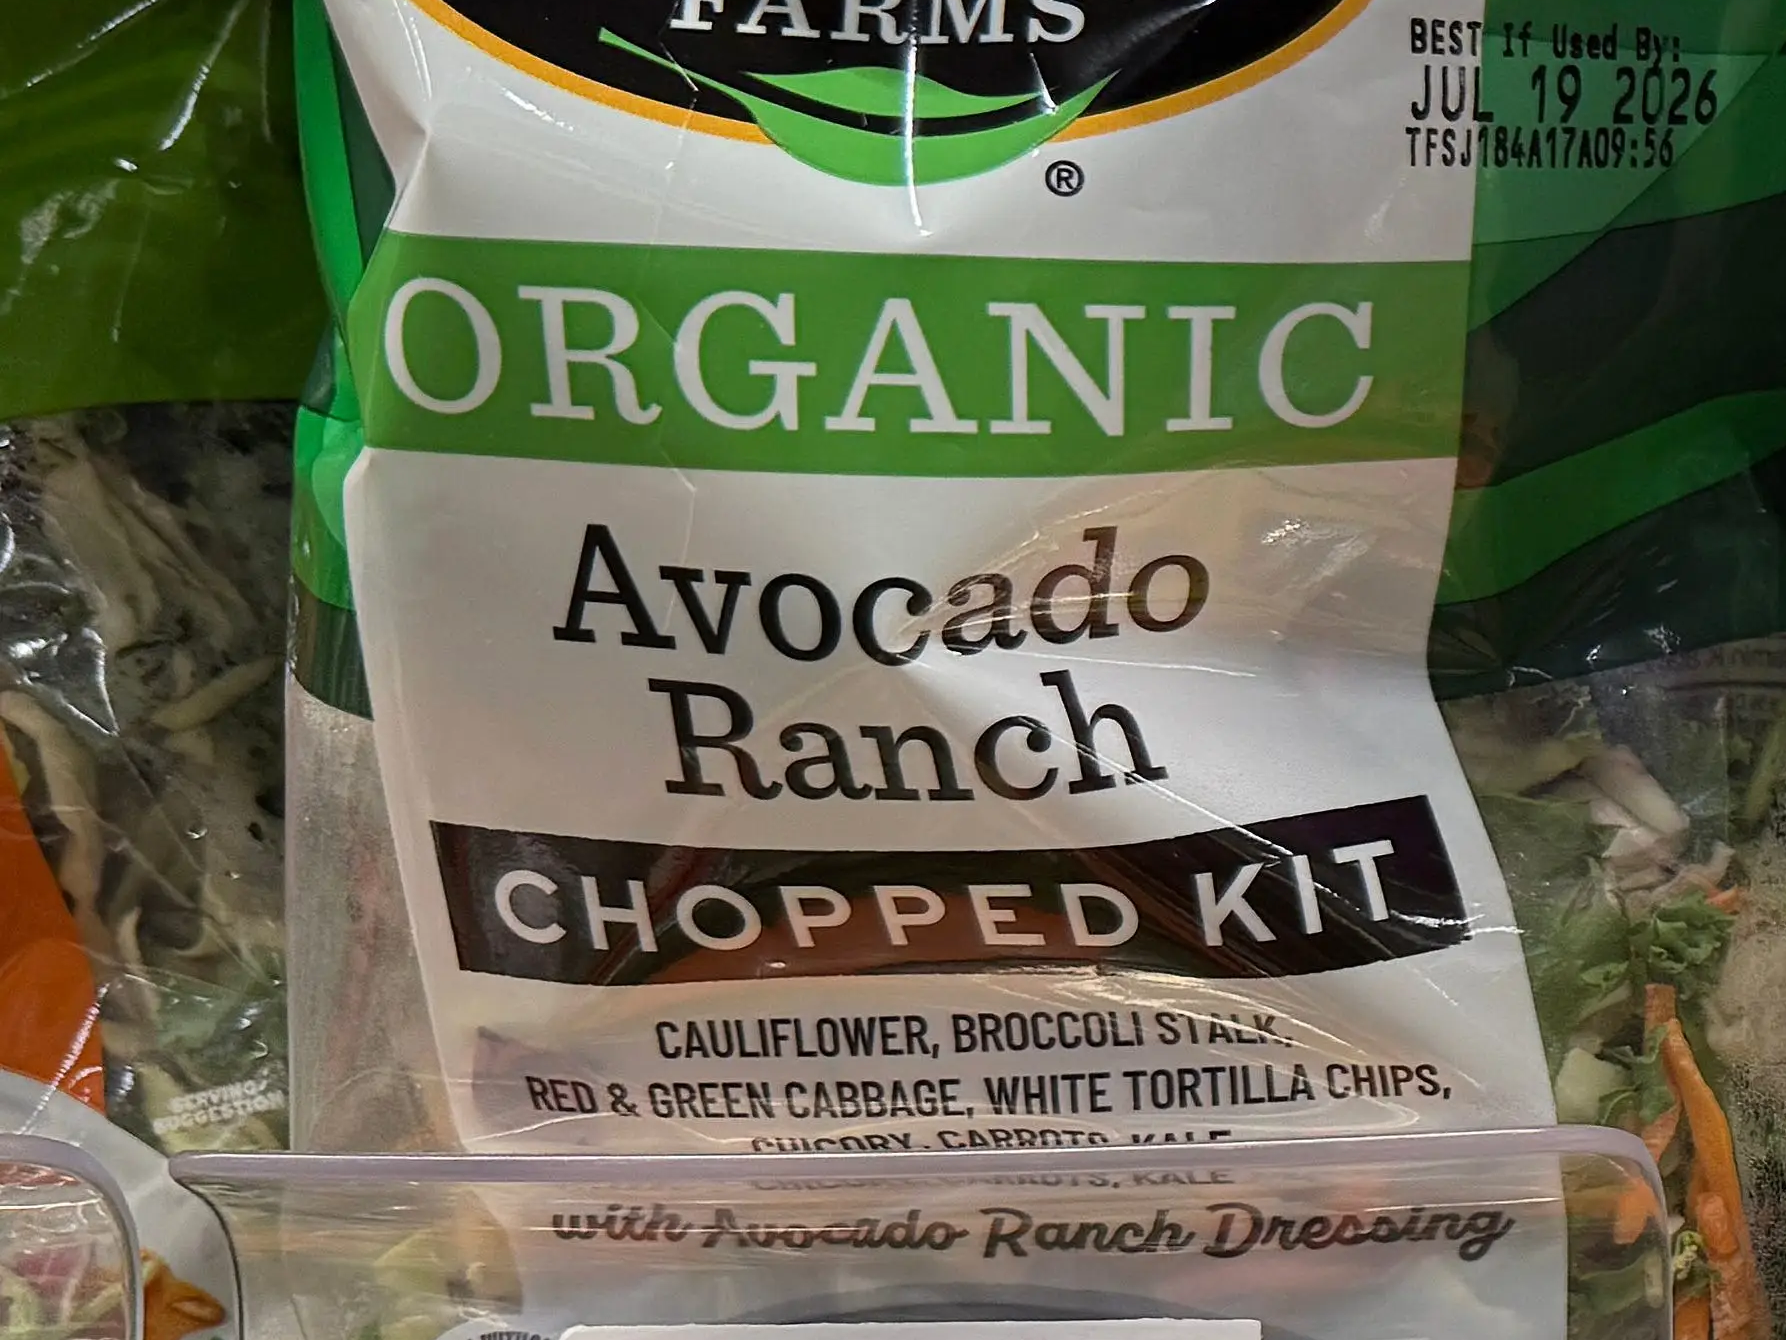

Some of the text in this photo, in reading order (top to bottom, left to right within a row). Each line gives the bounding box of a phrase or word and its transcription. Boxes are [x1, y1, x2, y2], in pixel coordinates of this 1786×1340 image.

[1410, 19, 1681, 69] BEST If Used By:
[1410, 65, 1718, 125] JUL 19 2026
[382, 277, 1375, 436] ORGANIC
[552, 524, 1209, 666] Avocado
[648, 671, 1169, 802] Ranch
[493, 839, 1397, 952] CHOPPED KIT
[654, 1014, 940, 1062] CAULIFLOWER,
[953, 1017, 1148, 1054] BROCCOLI
[526, 1062, 1451, 1122] RED & GREEN CABBAGE, WHITE TORTILLA CHIPS,
